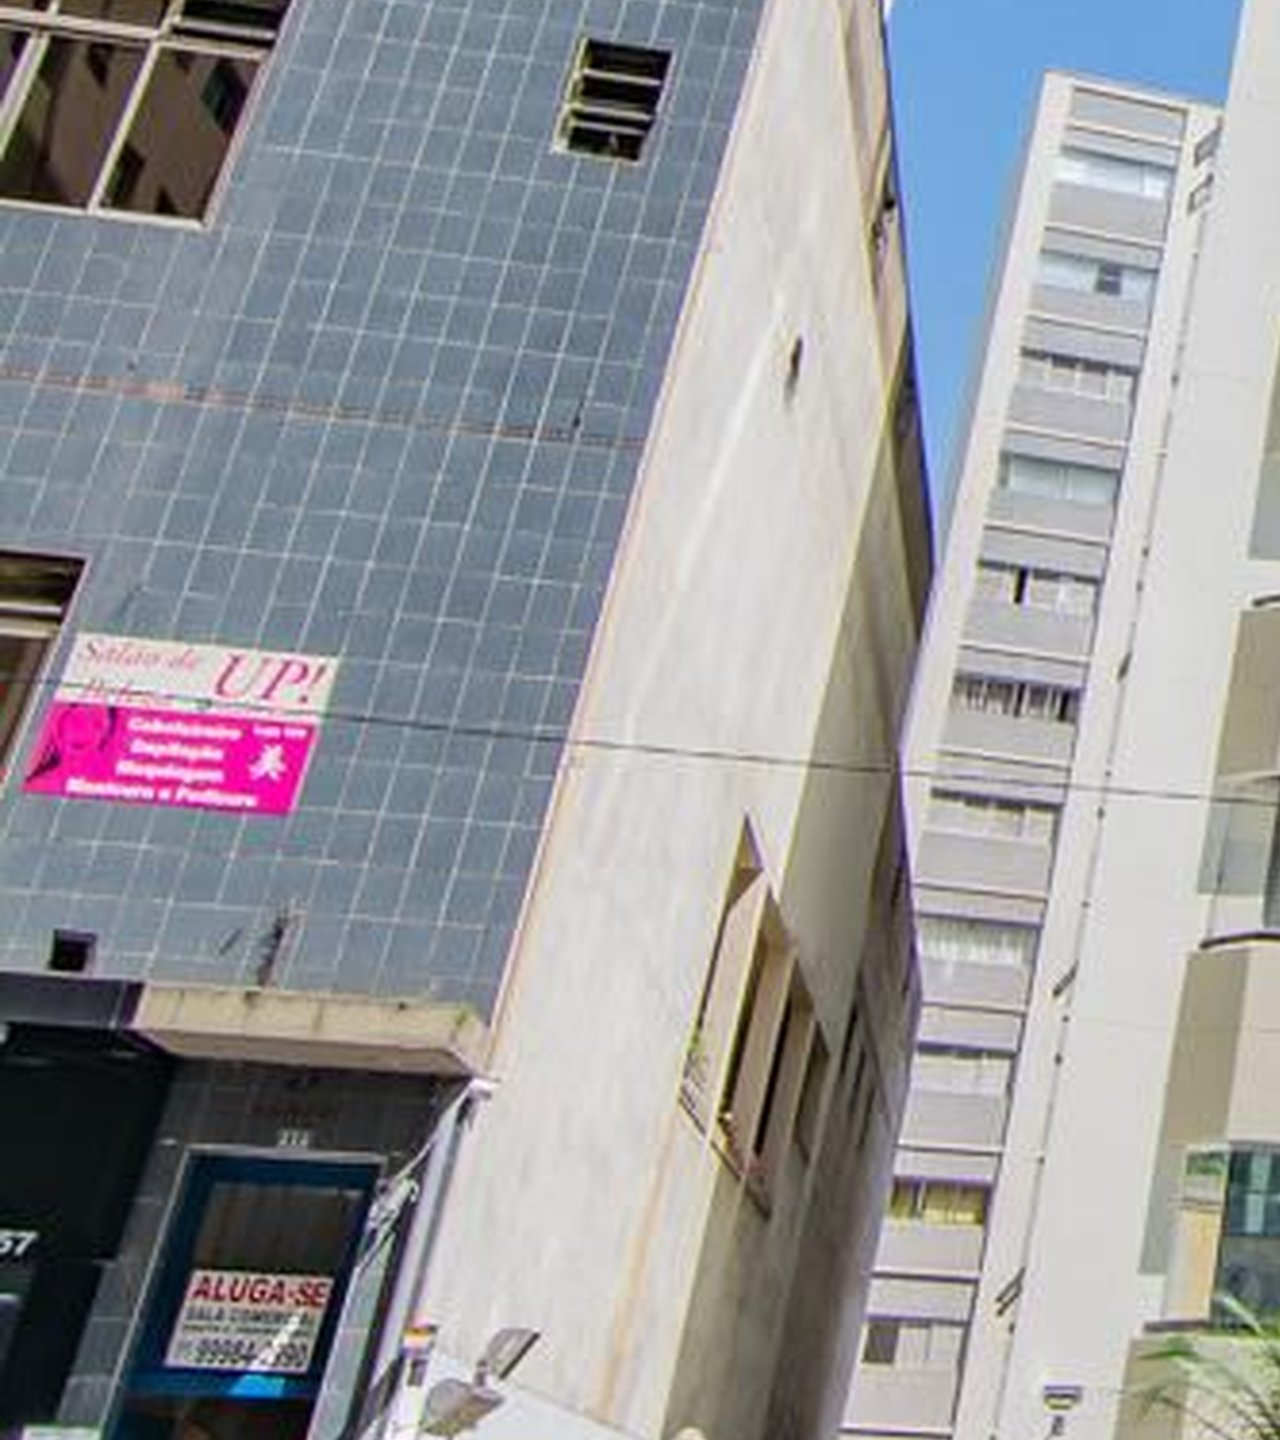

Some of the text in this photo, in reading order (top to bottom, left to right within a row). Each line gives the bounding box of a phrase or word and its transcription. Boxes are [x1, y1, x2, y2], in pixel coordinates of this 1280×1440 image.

[213, 653, 327, 705] UP!
[193, 1274, 327, 1308] ALUGA-SE
[229, 1307, 316, 1326] COMERCAL
